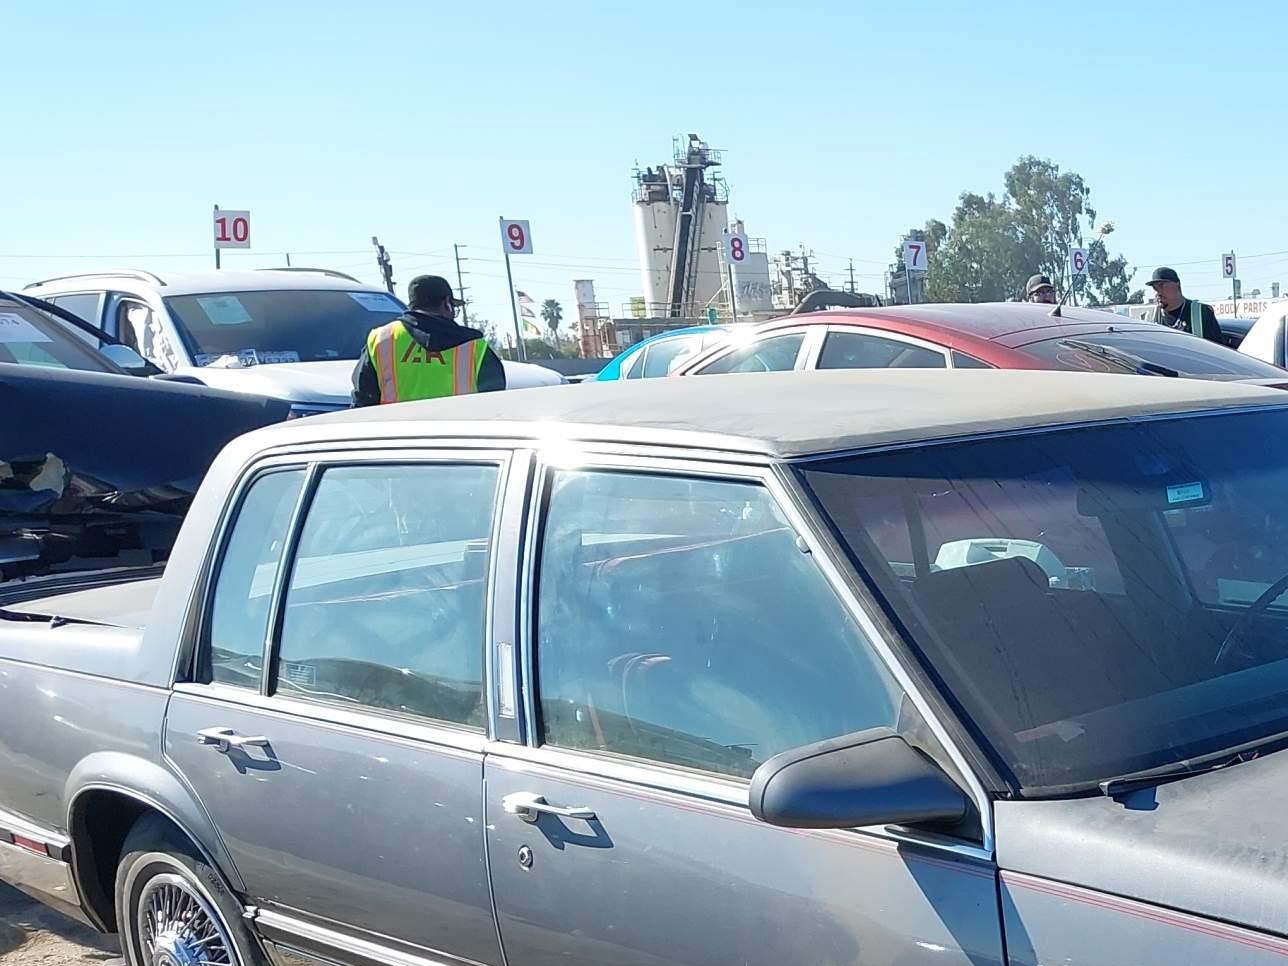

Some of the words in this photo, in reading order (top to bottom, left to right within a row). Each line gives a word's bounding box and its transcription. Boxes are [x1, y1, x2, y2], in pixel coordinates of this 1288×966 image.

[215, 217, 249, 242] 10
[507, 224, 524, 250] 9
[731, 237, 744, 261] 8
[909, 245, 921, 266] 7
[1074, 251, 1084, 271] 6
[1225, 257, 1233, 275] 5
[1244, 302, 1268, 314] PARTS
